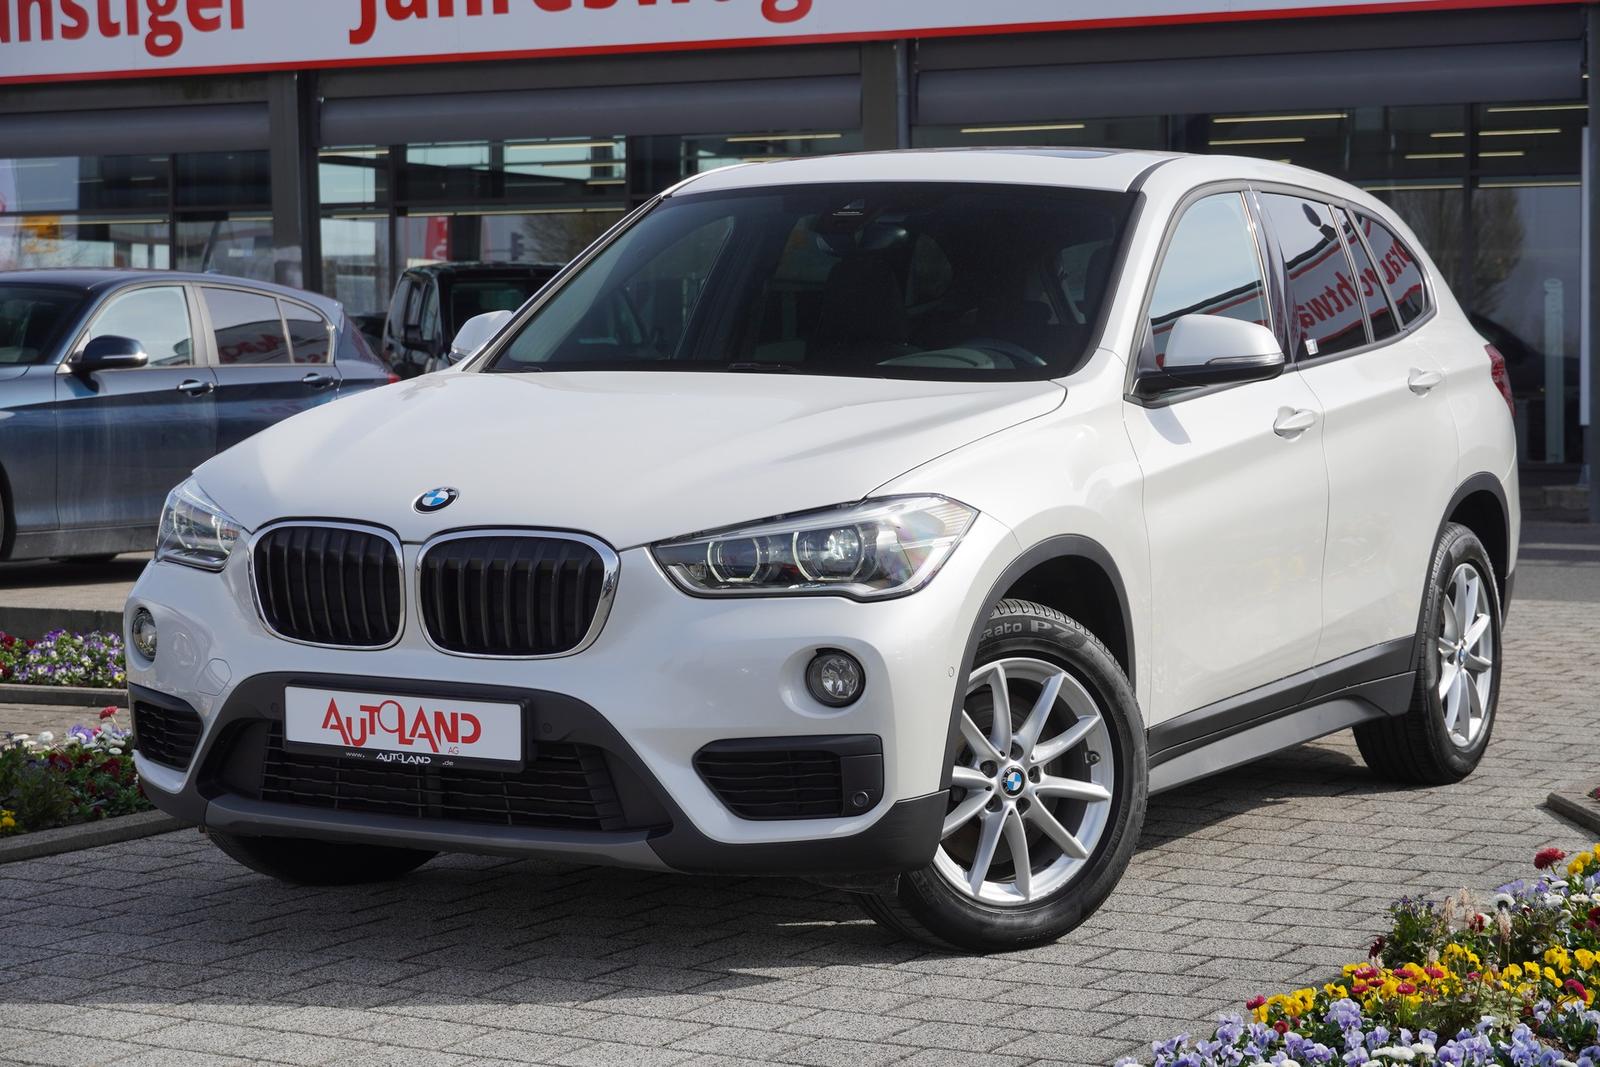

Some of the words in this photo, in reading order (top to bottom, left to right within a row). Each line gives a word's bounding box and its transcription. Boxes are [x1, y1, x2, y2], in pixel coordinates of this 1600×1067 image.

[322, 698, 481, 753] AUTOLAND
[448, 746, 459, 755] AG
[376, 752, 431, 765] AUTOLAND
